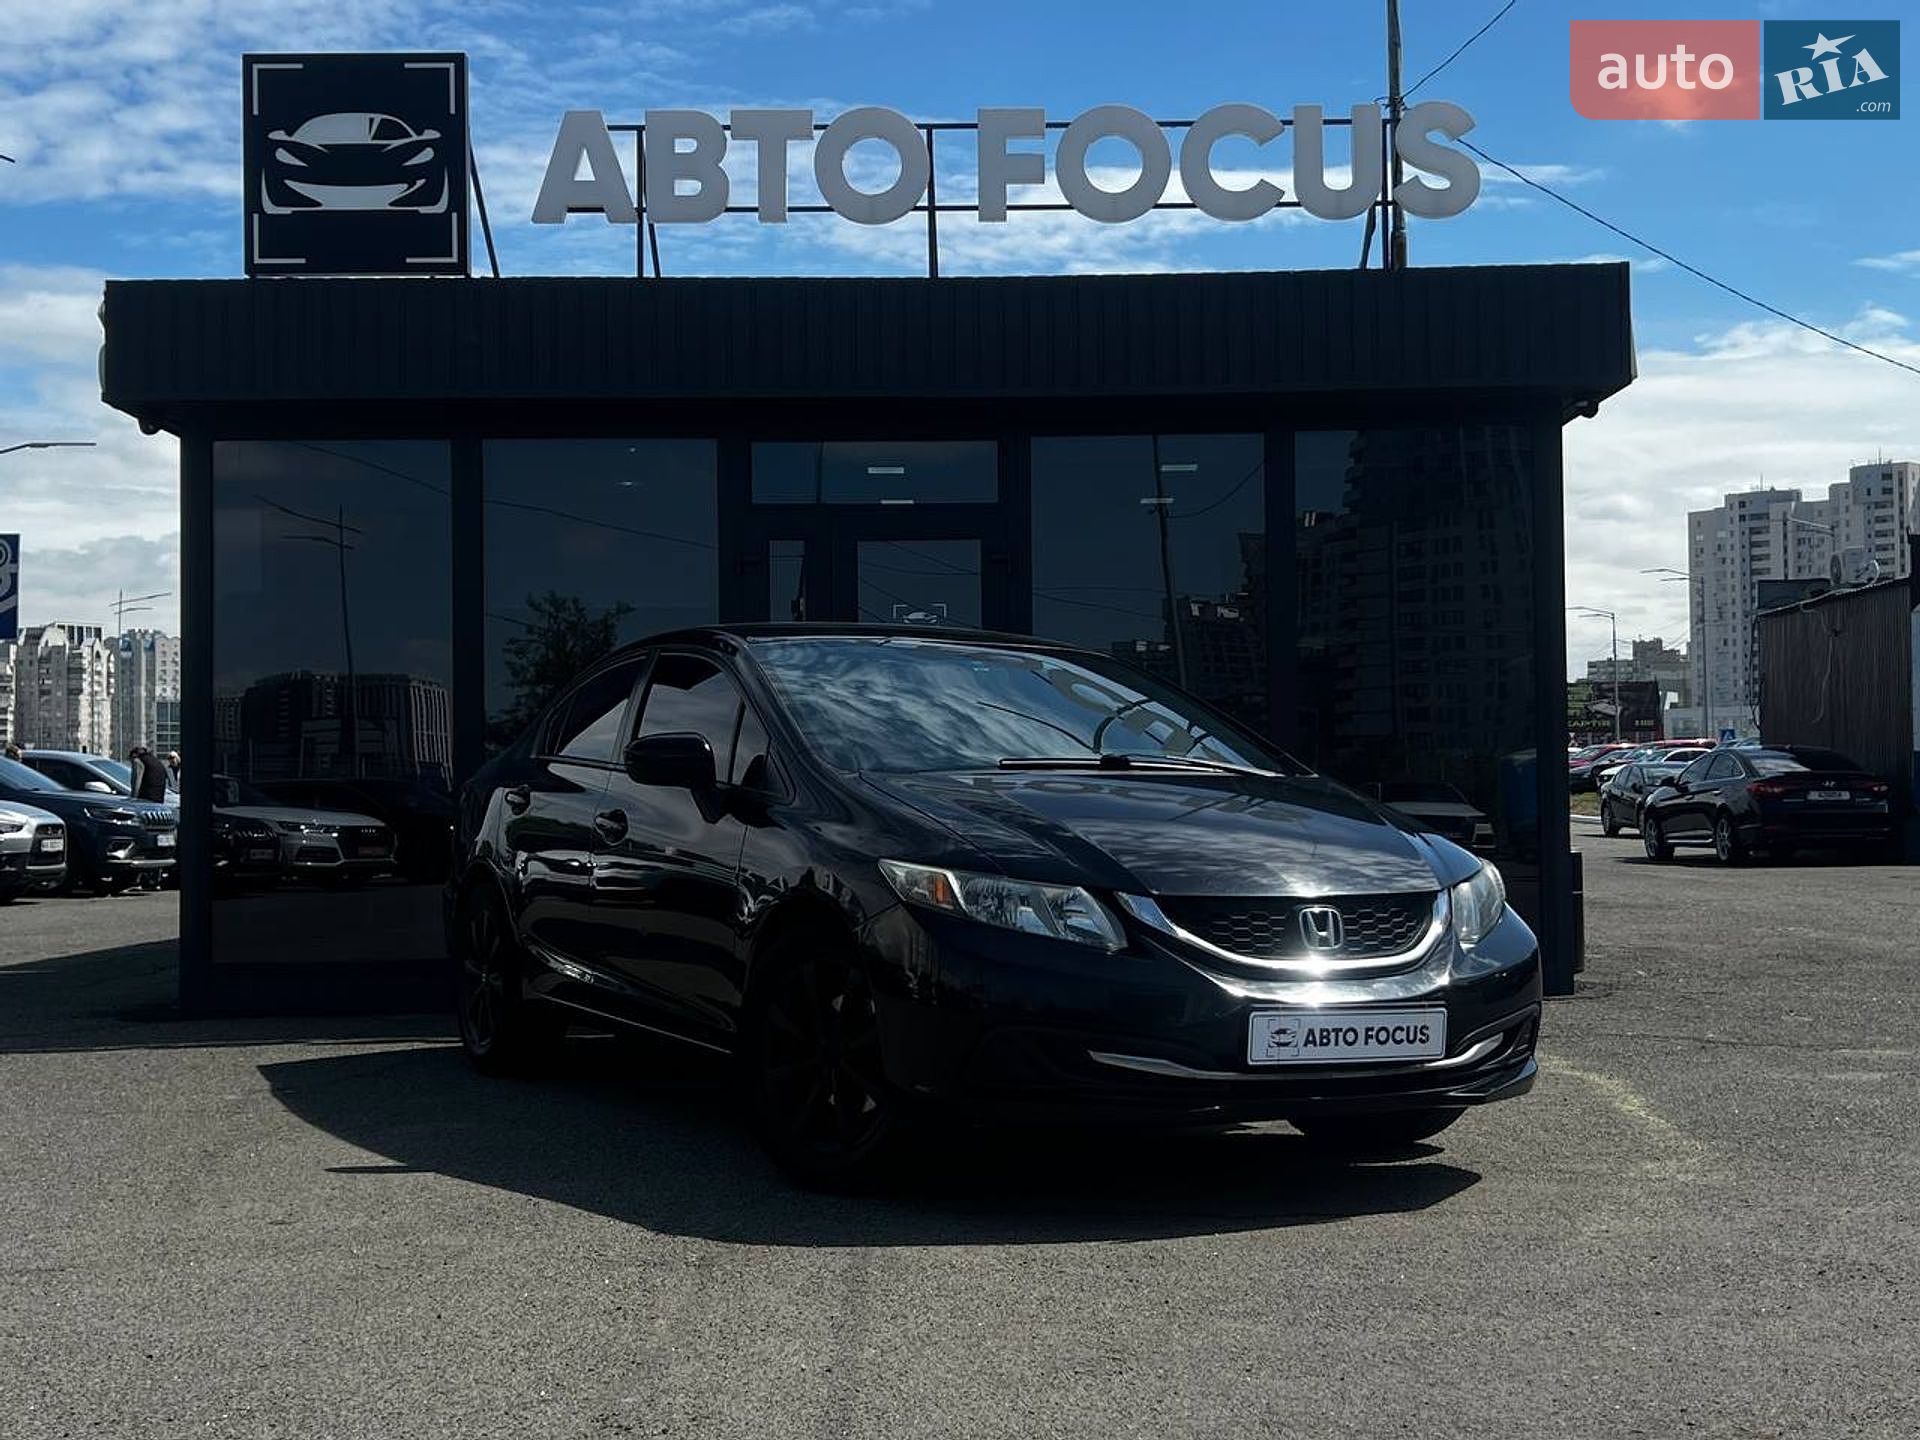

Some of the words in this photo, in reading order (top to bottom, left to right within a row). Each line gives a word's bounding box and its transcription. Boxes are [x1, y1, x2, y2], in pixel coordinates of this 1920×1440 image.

[532, 105, 930, 225] АВТО
[978, 102, 1481, 223] FOCUS
[1303, 1028, 1358, 1047] АВТО
[1364, 1025, 1430, 1045] FOCUS
